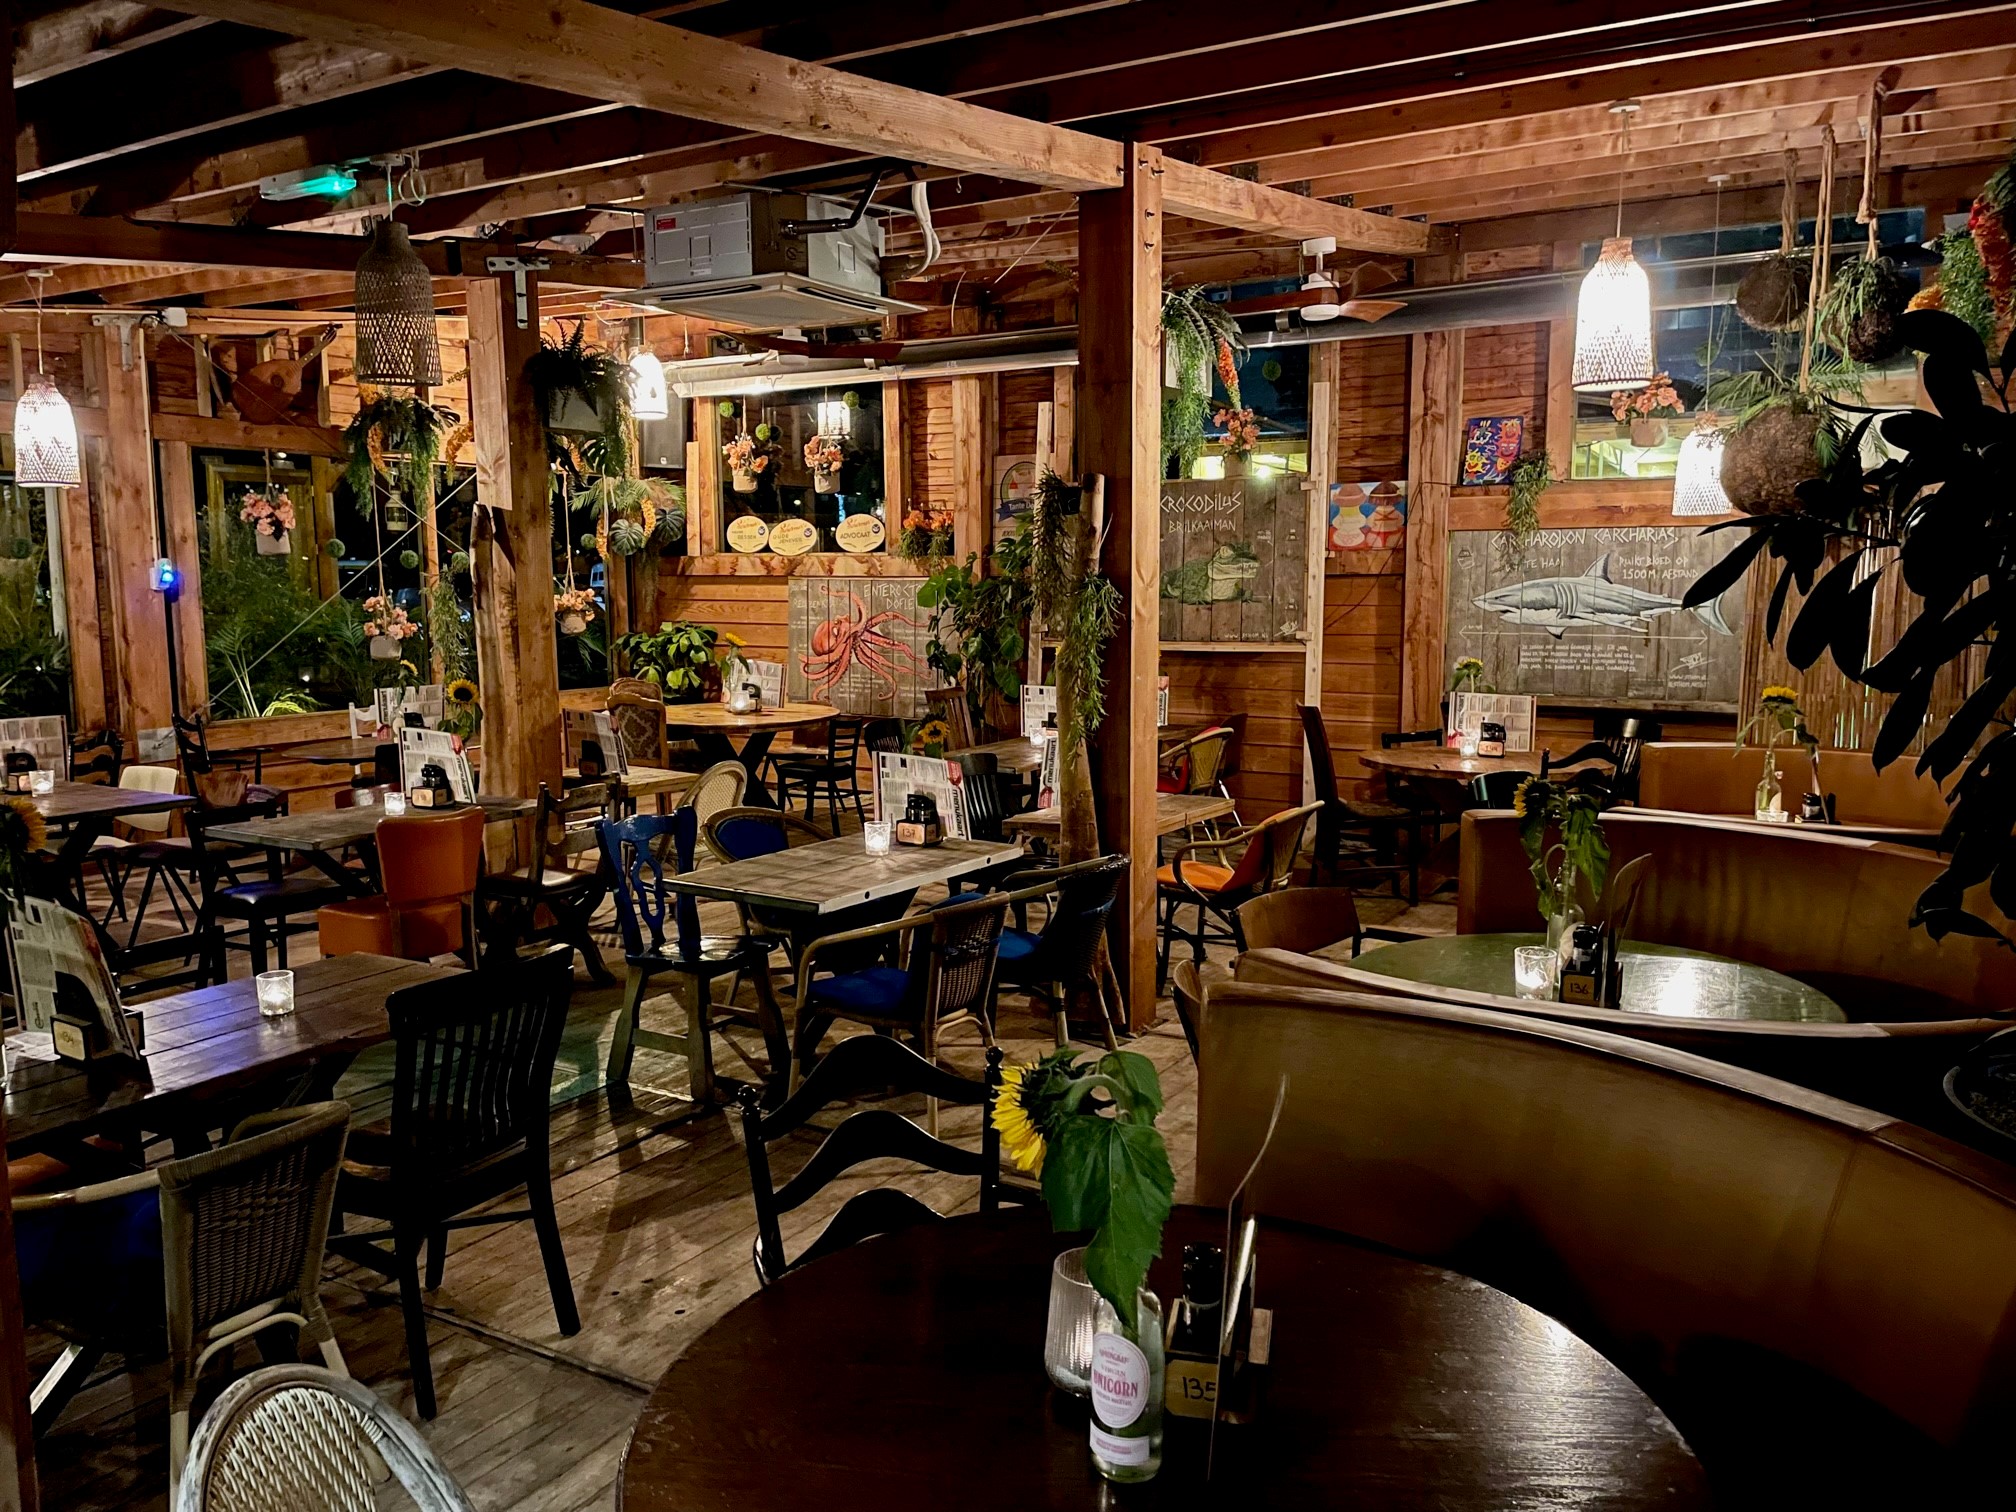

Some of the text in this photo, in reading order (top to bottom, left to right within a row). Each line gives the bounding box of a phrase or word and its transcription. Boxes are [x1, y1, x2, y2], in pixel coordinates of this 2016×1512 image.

[1168, 519, 1236, 534] BRILKAAIMAN
[840, 531, 870, 539] ADVOCAAT
[1676, 556, 1688, 567] OP
[1662, 568, 1698, 579] AFSTAND
[864, 583, 923, 597] ENTEROCTO
[886, 598, 918, 610] DOFLE
[1047, 738, 1058, 784] menukaart
[952, 789, 965, 837] menukaart
[1570, 982, 1589, 995] 136
[1093, 1369, 1138, 1398] UNICORN
[1183, 1376, 1217, 1402] 135
